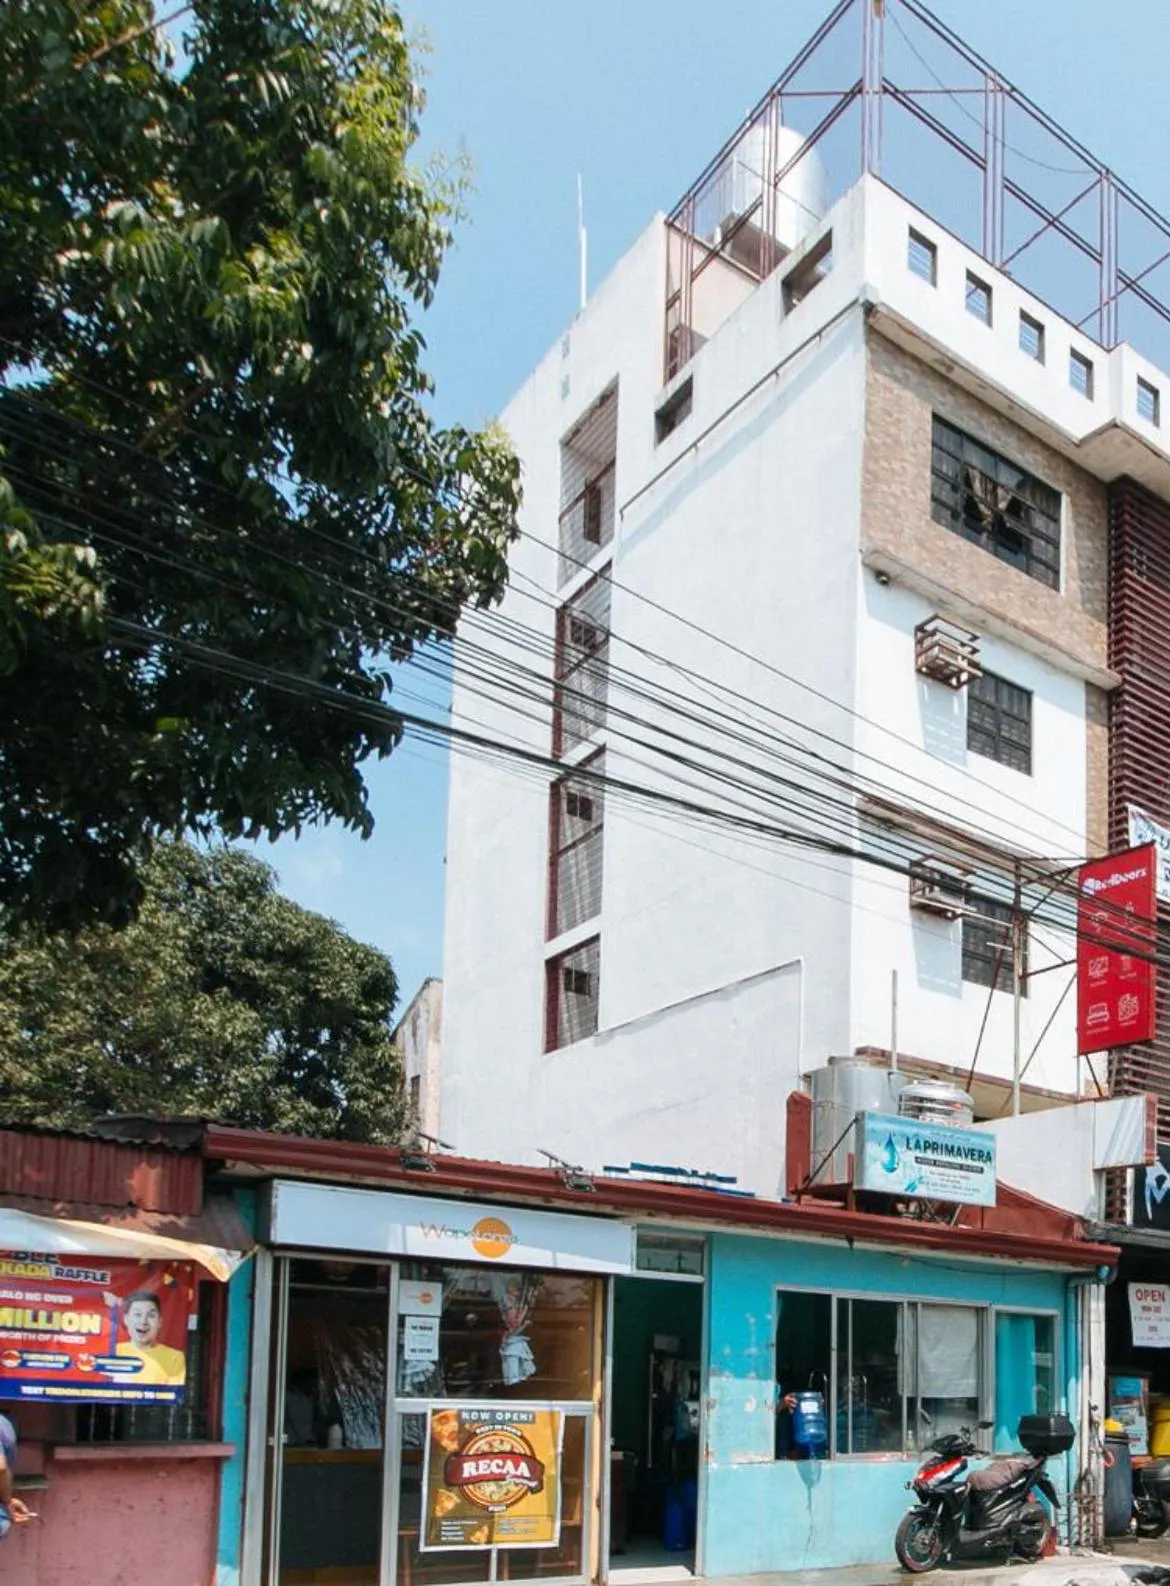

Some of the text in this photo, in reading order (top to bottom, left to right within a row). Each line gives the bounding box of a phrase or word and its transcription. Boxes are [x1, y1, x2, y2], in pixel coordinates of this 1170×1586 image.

[54, 1266, 110, 1283] RAFFLE
[1135, 1288, 1166, 1303] OPEN
[461, 1411, 532, 1421] NOW OPEN!
[462, 1459, 531, 1478] RECAA
